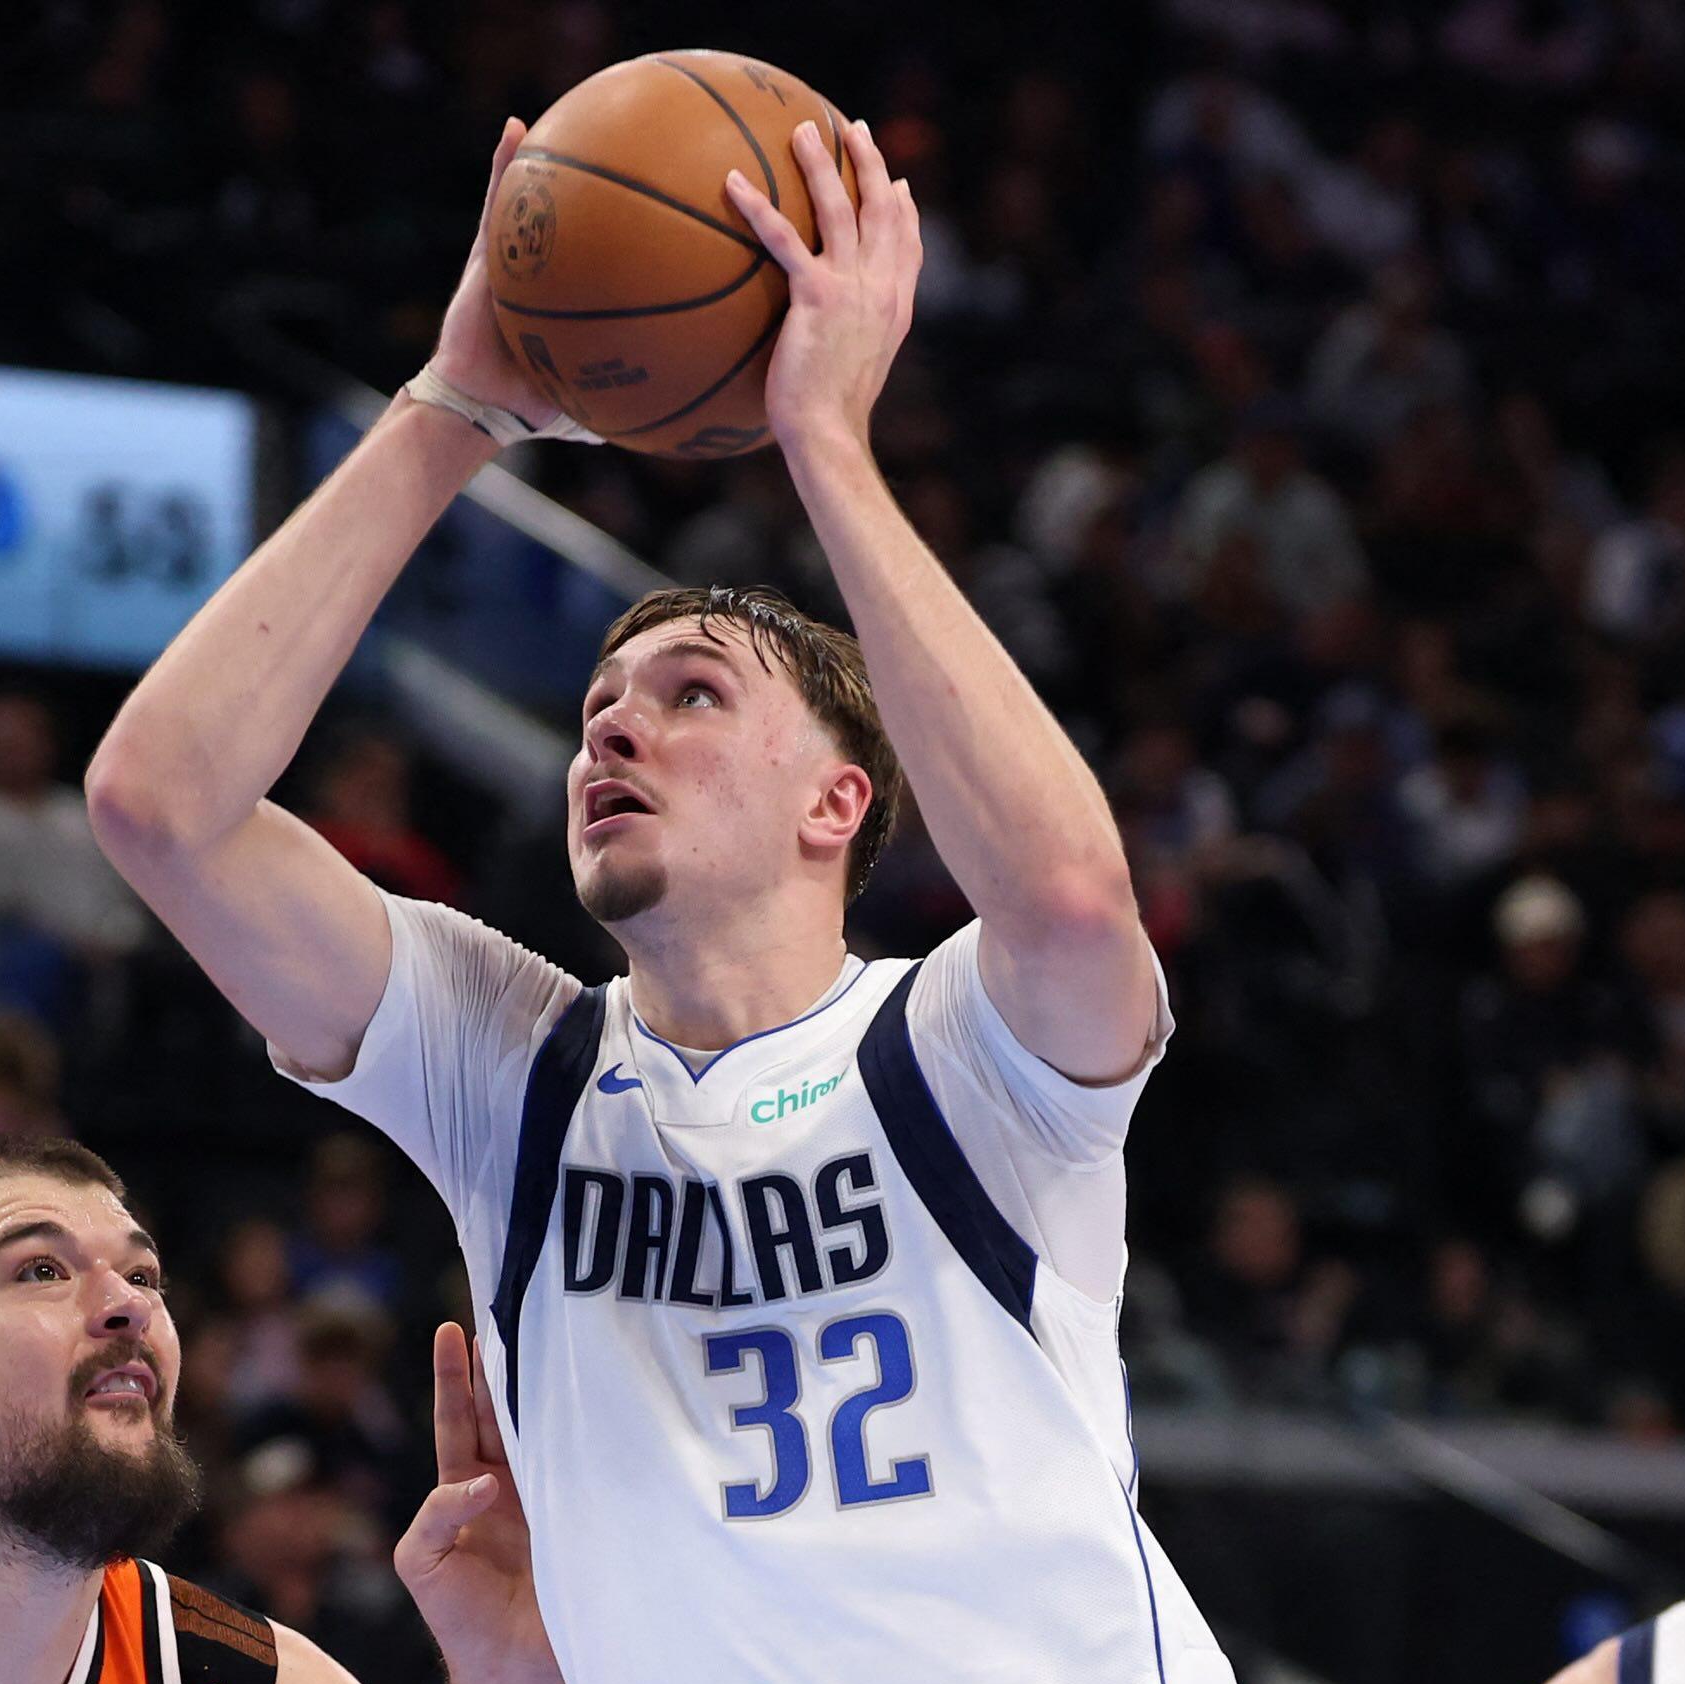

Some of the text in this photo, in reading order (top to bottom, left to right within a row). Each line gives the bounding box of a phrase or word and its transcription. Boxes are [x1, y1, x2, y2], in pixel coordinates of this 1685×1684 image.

[751, 1066, 849, 1123] chim
[562, 1148, 894, 1309] DALLAS
[701, 1308, 936, 1522] 32
